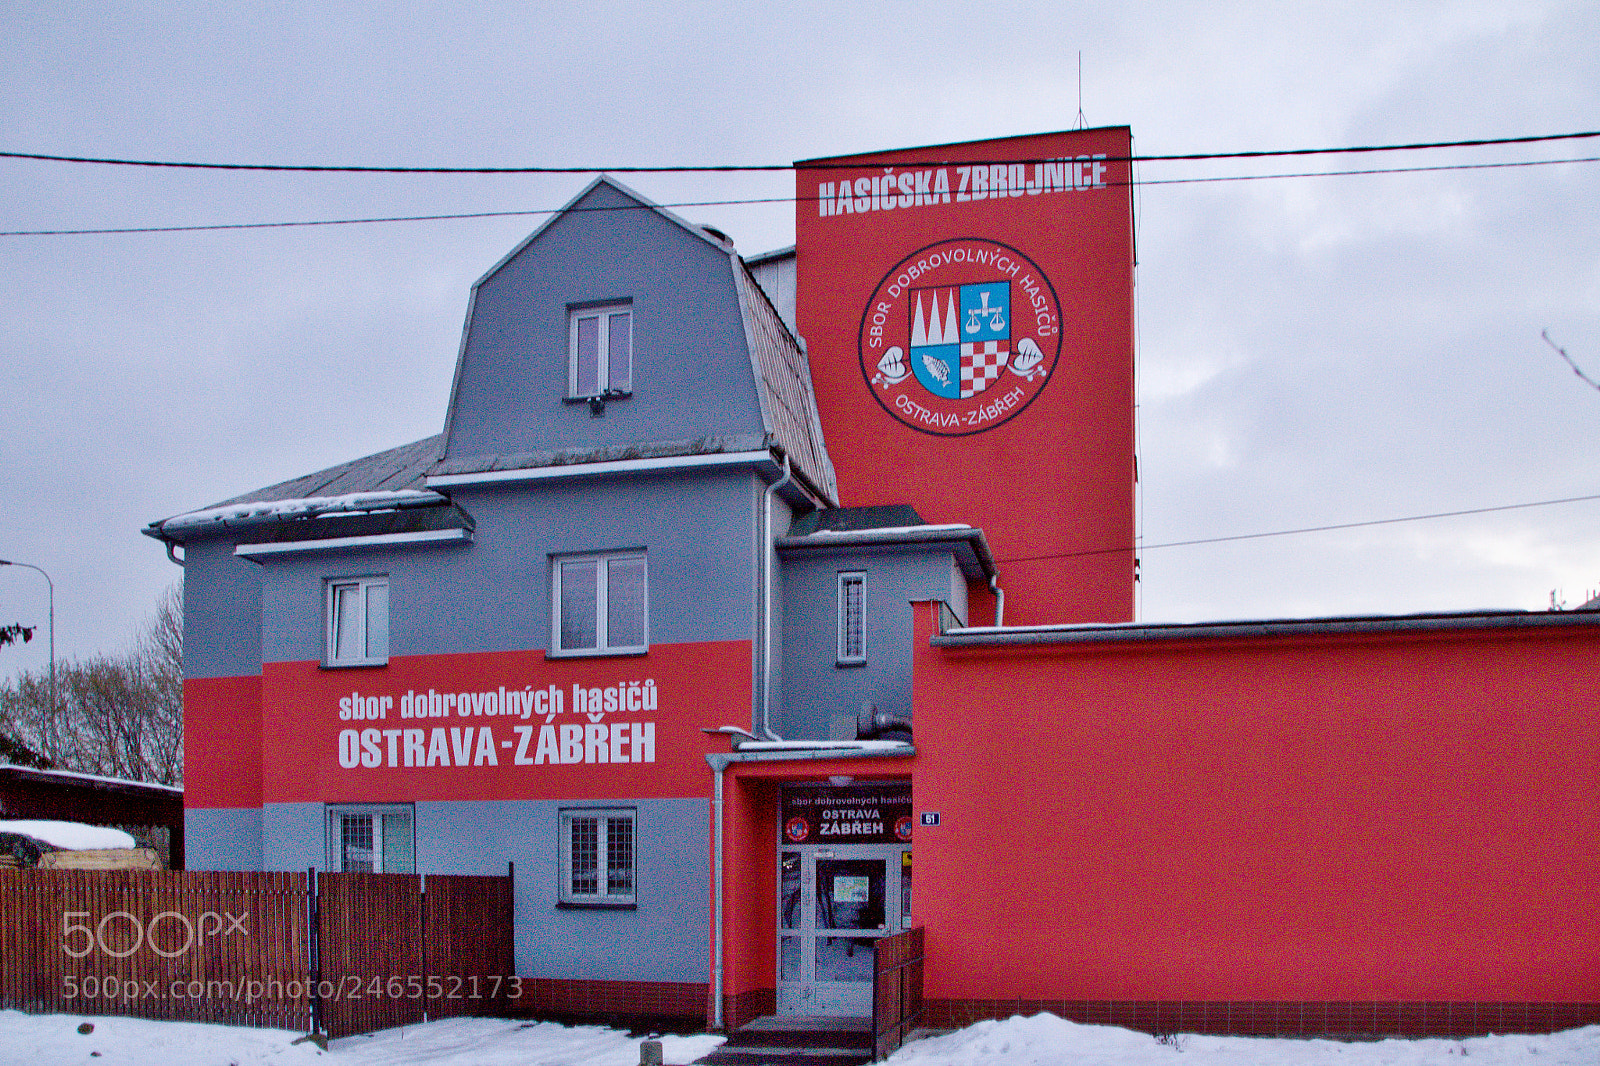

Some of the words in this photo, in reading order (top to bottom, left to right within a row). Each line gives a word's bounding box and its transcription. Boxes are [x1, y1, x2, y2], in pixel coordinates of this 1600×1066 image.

[819, 161, 950, 217] HASIČSKÁ
[956, 153, 1107, 202] ZBROJNICE
[869, 301, 892, 348] SBOR
[888, 248, 1020, 298] DOBROVOLNÝCH
[1019, 274, 1058, 337] HASIČŮ
[338, 692, 393, 721] sbor
[400, 685, 564, 719] dobrovolných
[573, 679, 658, 713] hasičů
[820, 821, 884, 835] ZÁBŘEH
[822, 809, 880, 820] OSTRAVA
